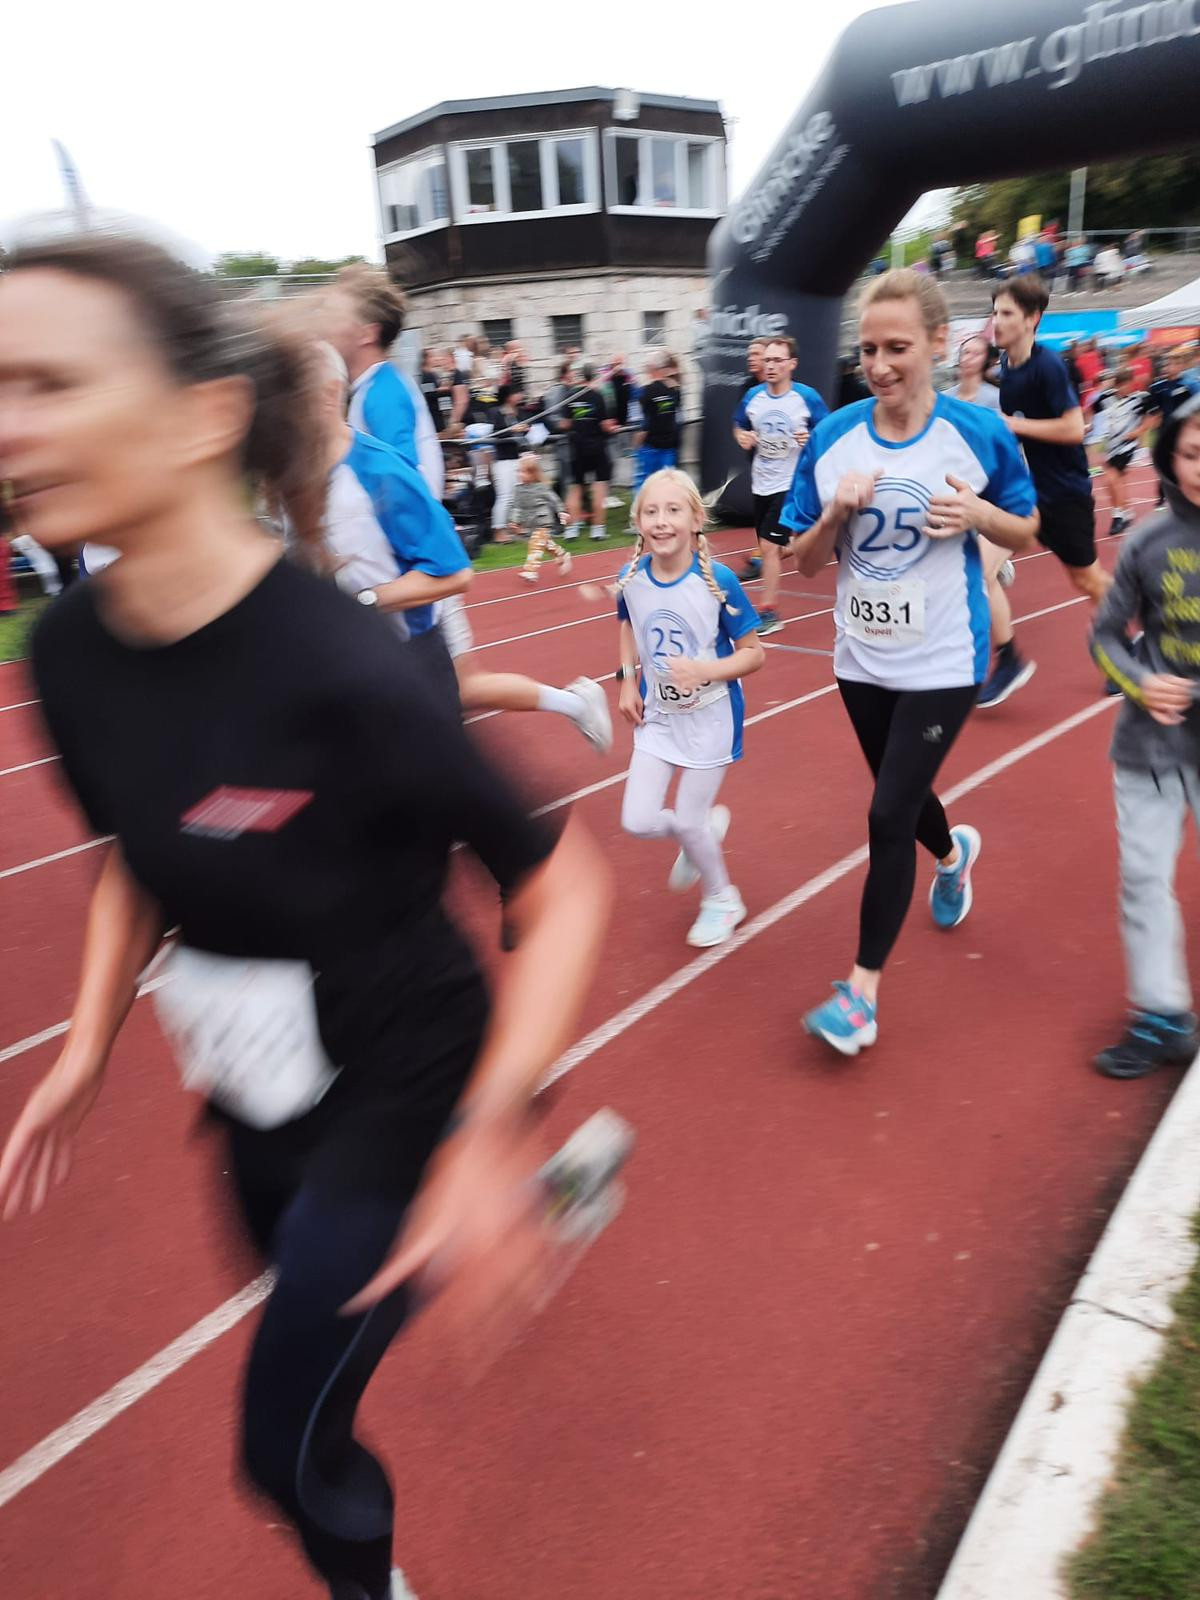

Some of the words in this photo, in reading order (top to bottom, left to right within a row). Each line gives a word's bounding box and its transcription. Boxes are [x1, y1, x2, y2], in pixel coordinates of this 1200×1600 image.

[857, 507, 921, 552] 25
[850, 596, 911, 625] 033.1
[651, 627, 684, 657] 25
